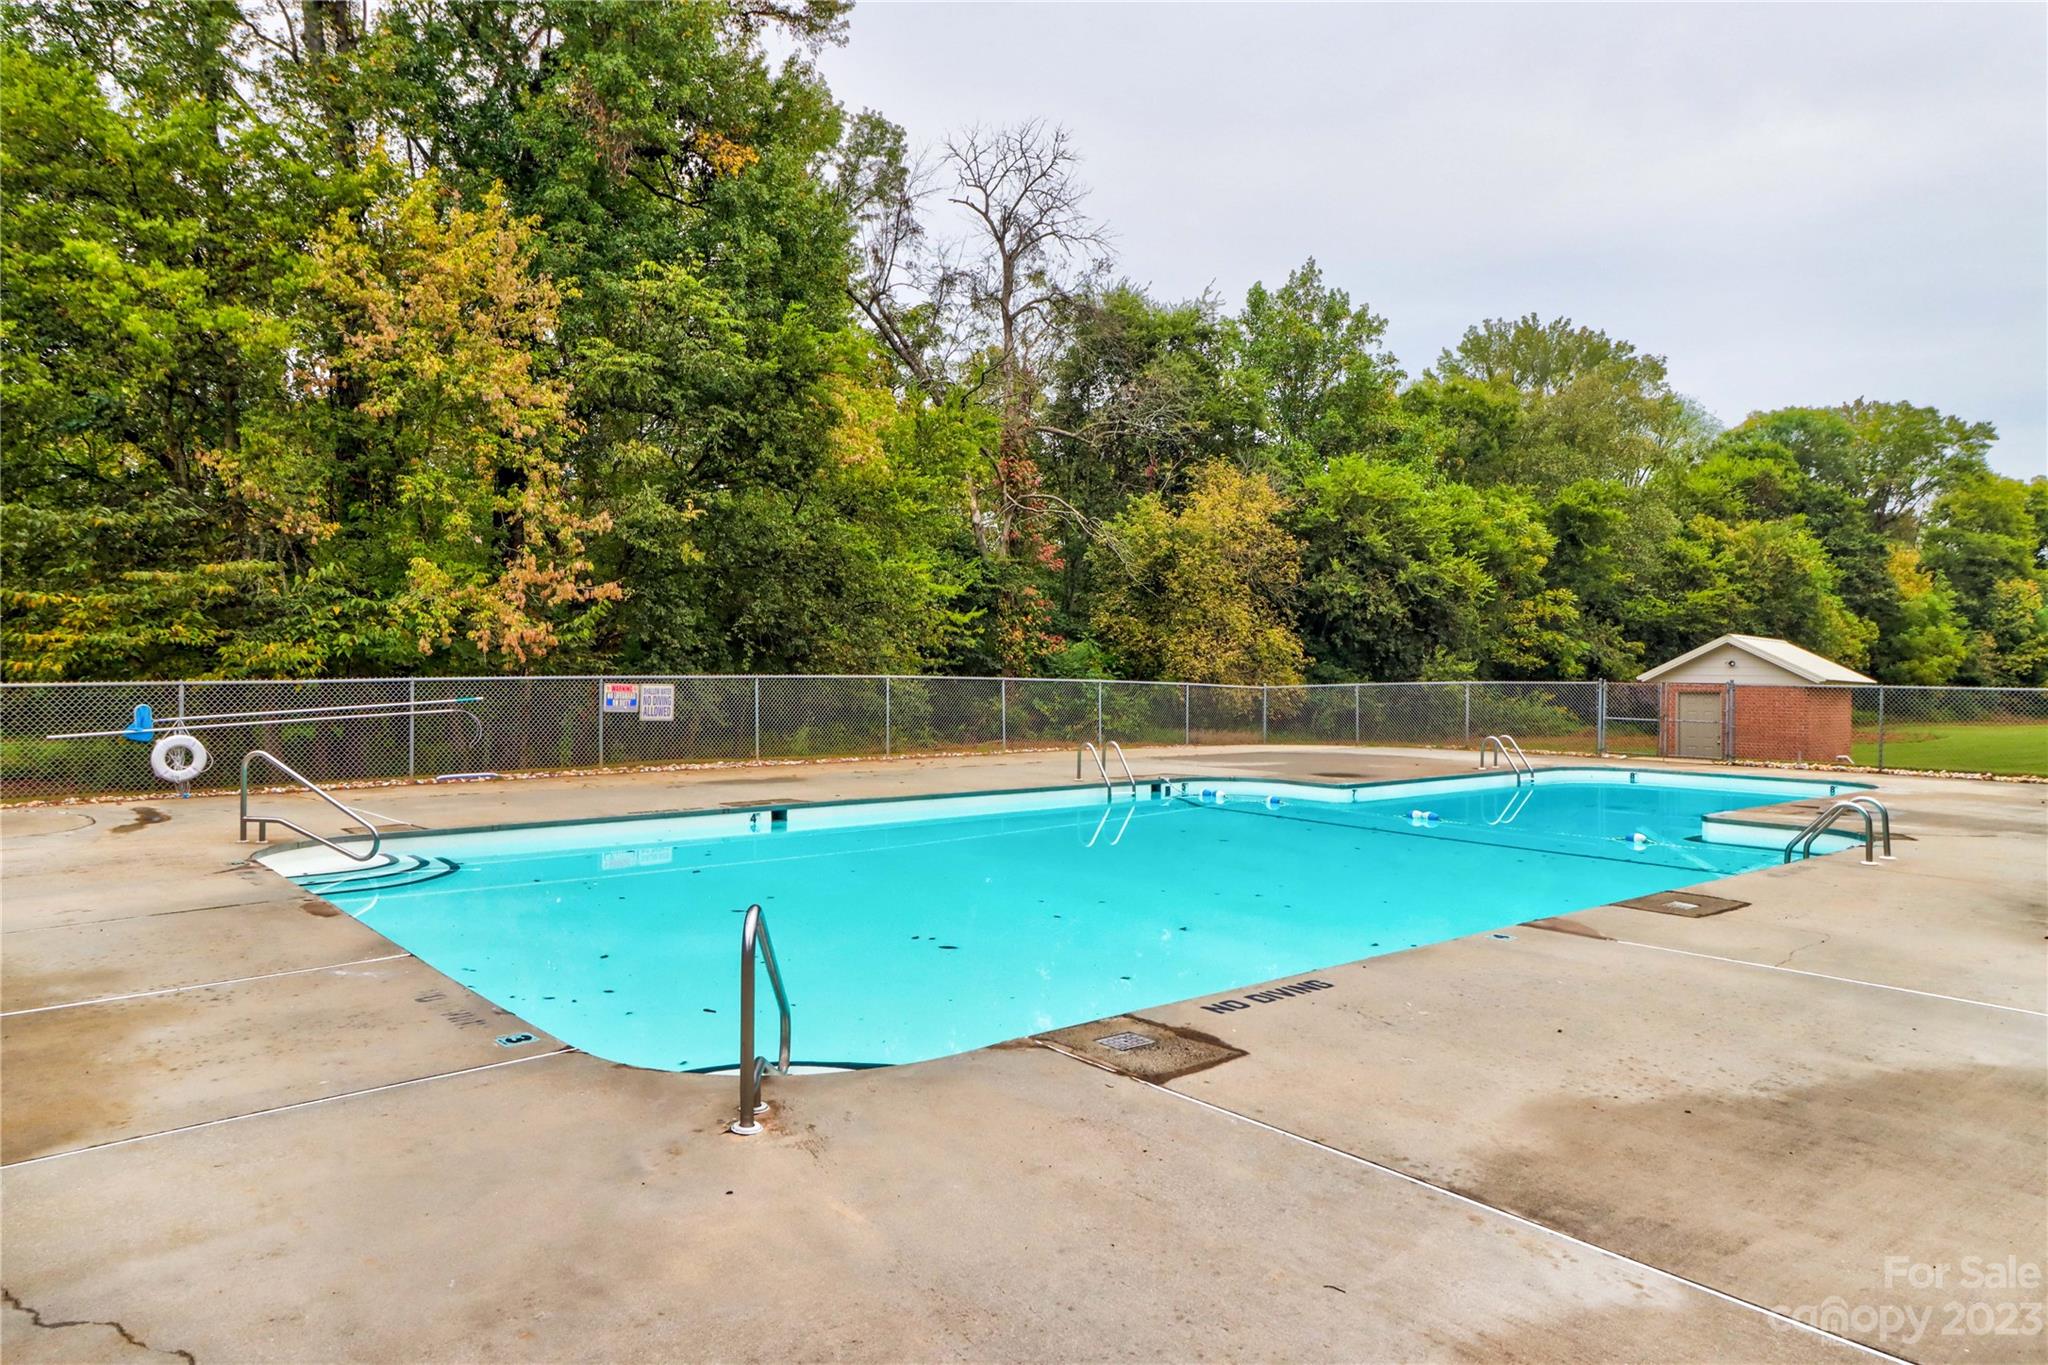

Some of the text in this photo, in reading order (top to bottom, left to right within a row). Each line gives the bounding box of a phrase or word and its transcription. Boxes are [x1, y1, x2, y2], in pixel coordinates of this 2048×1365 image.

[643, 696, 651, 705] NO
[653, 696, 671, 705] DIVING
[643, 707, 671, 716] ALLOWED
[1200, 980, 1334, 1014] NO DIVING
